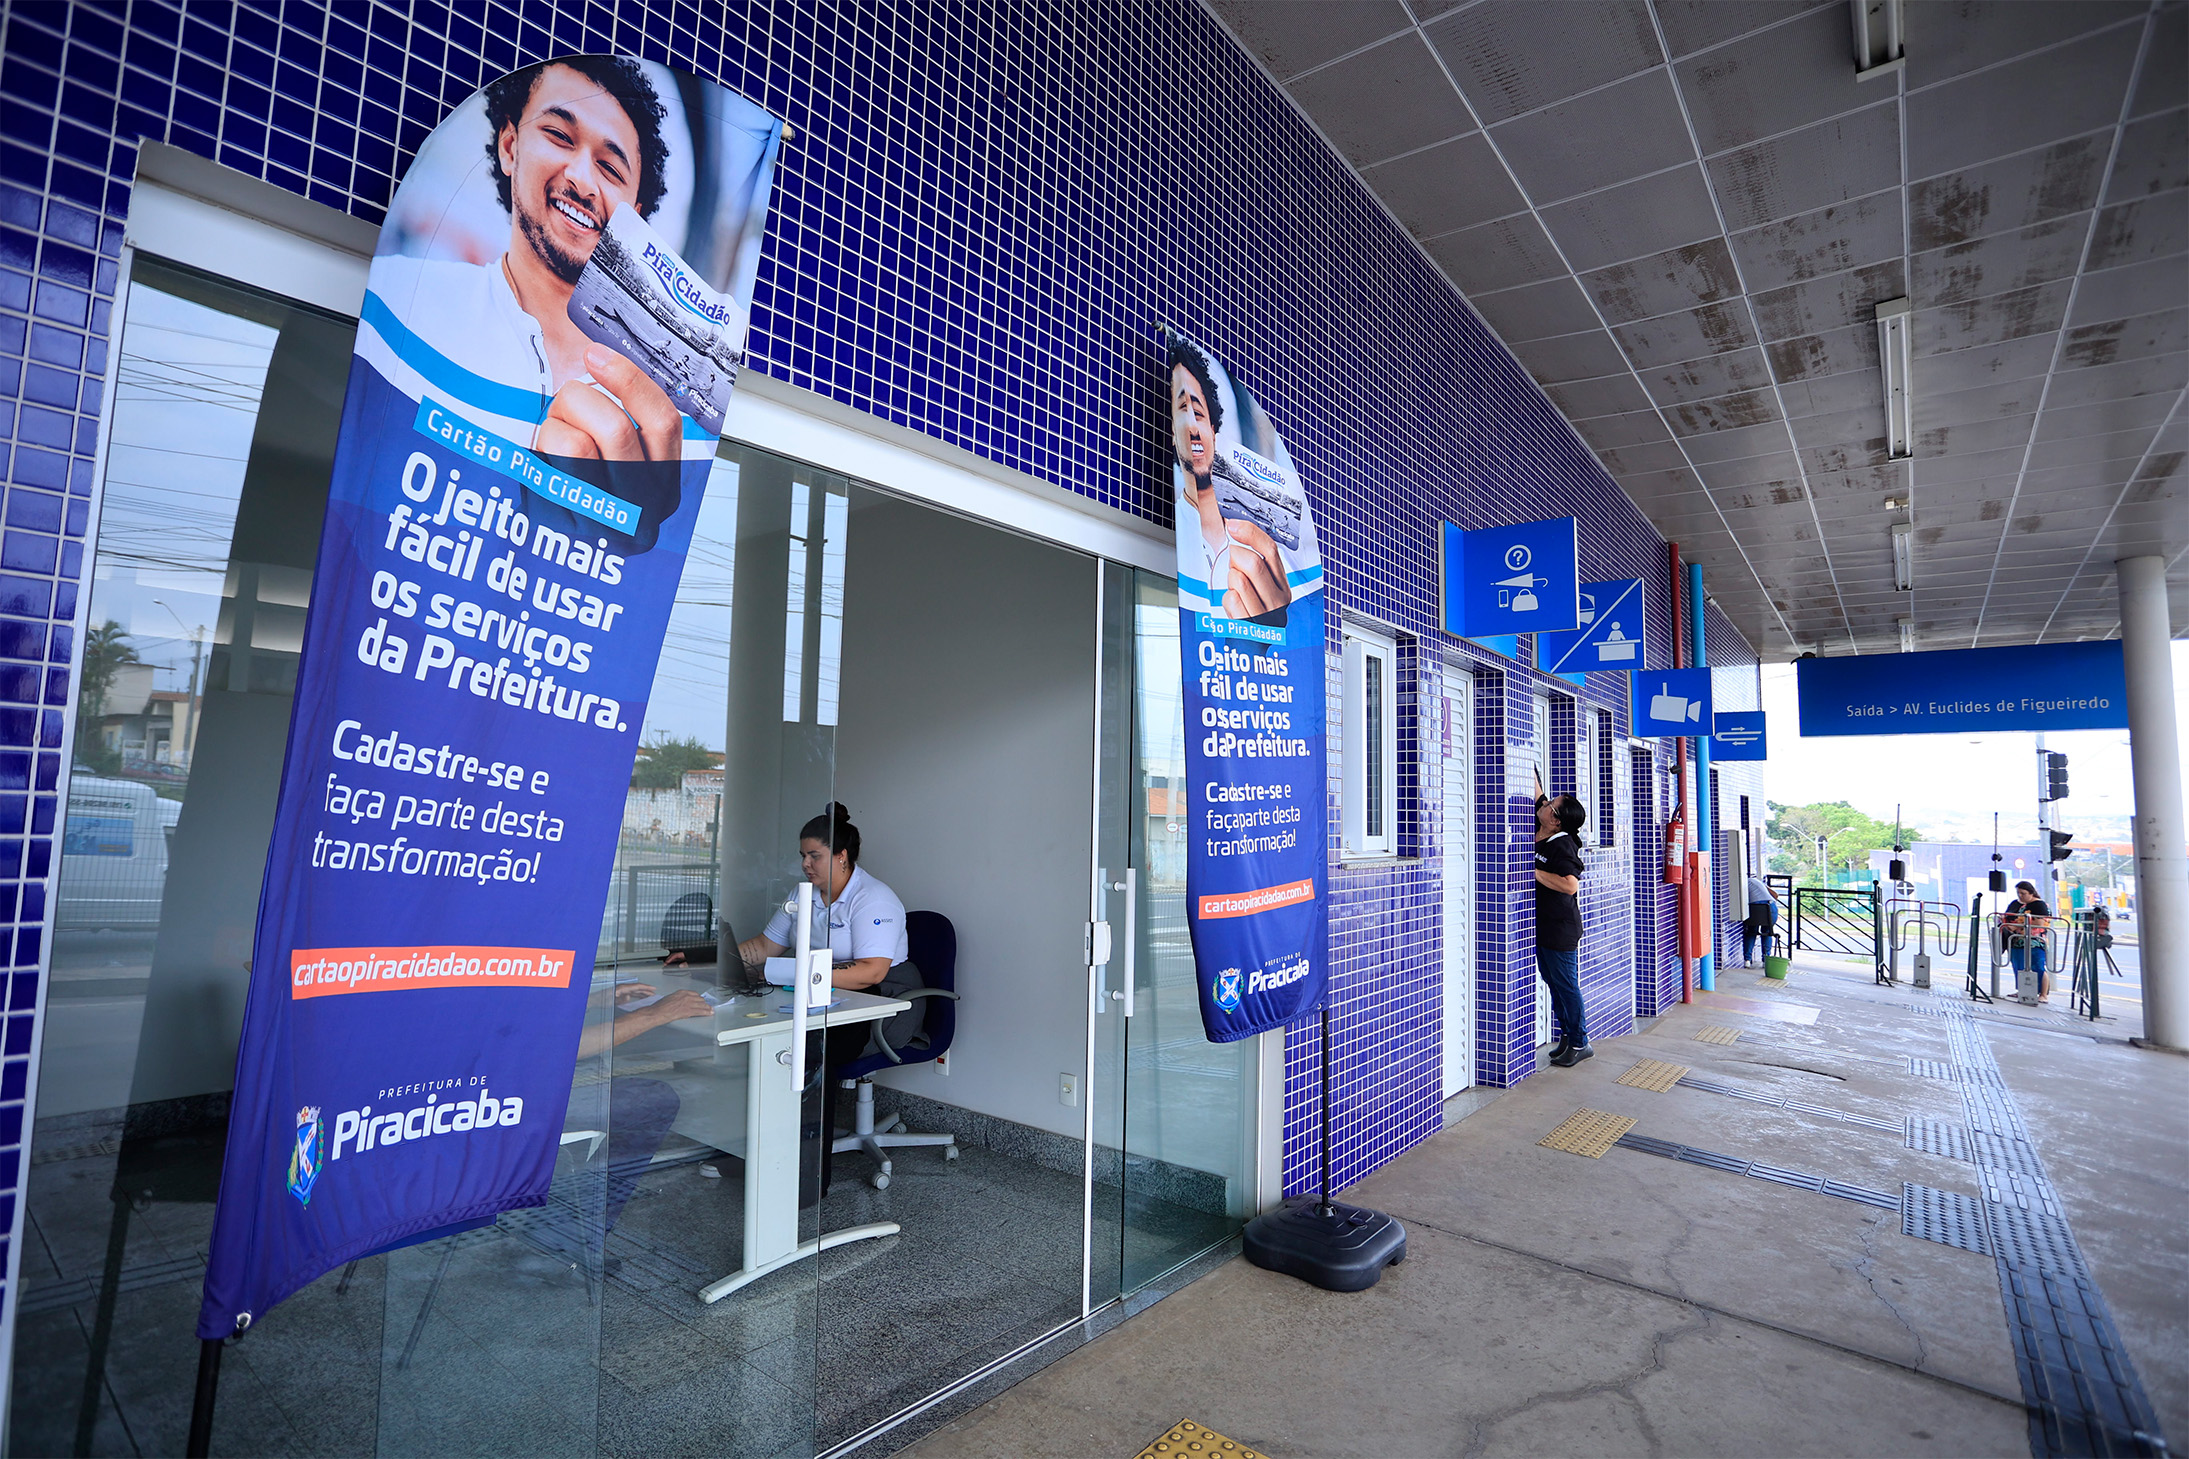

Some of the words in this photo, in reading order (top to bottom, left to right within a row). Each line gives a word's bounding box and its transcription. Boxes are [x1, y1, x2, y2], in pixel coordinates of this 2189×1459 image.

[642, 241, 673, 281] Pira
[675, 273, 731, 326] Cidadão
[427, 409, 501, 463] Cartão
[509, 450, 543, 486] Pira
[549, 475, 628, 525] Cidadão
[1232, 449, 1252, 468] Pira
[1253, 460, 1286, 487] Cidadão
[401, 451, 437, 503] O
[432, 468, 530, 547] jeito
[531, 538, 625, 585] mais
[384, 503, 484, 582] fácil
[486, 550, 528, 601] de
[532, 577, 624, 632] usar
[371, 570, 422, 618] os
[424, 593, 593, 674] serviços
[1228, 621, 1249, 636] Pira
[1249, 625, 1282, 641] Cidadão
[357, 617, 409, 674] da
[414, 633, 627, 733] Prefeitura.
[1253, 651, 1289, 677] mais
[1236, 676, 1259, 701] de
[1261, 683, 1294, 704] usar
[1846, 704, 1884, 718] Saída
[1903, 701, 1923, 716] AV.
[1929, 700, 1991, 714] Euclides
[1996, 699, 2014, 712] de
[2020, 696, 2110, 714] Figueiredo
[332, 719, 524, 790] Cadastre-se
[530, 770, 550, 795] e
[324, 773, 386, 825] faça
[390, 795, 475, 831] parte
[480, 800, 565, 842] desta
[1284, 784, 1292, 799] e
[1273, 806, 1301, 825] desta
[312, 830, 542, 886] transformação!
[1206, 828, 1297, 857] transformação!
[1204, 883, 1311, 913] cartaopiracidadao.com.br
[293, 952, 564, 988] cartaopiracidadao.com.br
[1248, 957, 1310, 995] Piracicaba
[378, 1078, 462, 1100] PREFEITURA
[469, 1075, 488, 1086] DE
[331, 1088, 524, 1161] Piracicaba
